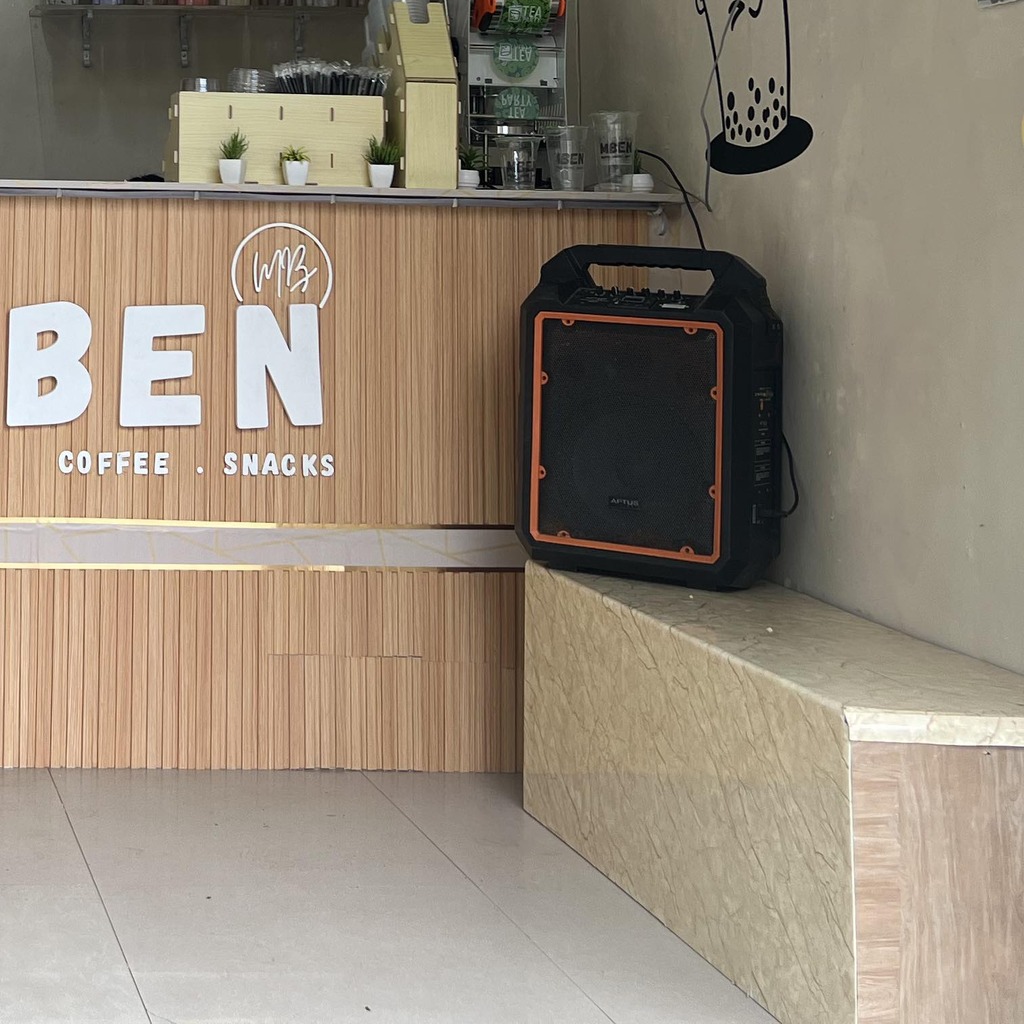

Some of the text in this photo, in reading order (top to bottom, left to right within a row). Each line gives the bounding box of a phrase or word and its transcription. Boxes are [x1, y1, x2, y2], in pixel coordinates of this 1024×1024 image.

[600, 141, 632, 154] MBEN
[58, 450, 170, 475] COFFEE
[223, 452, 335, 476] SNACKS
